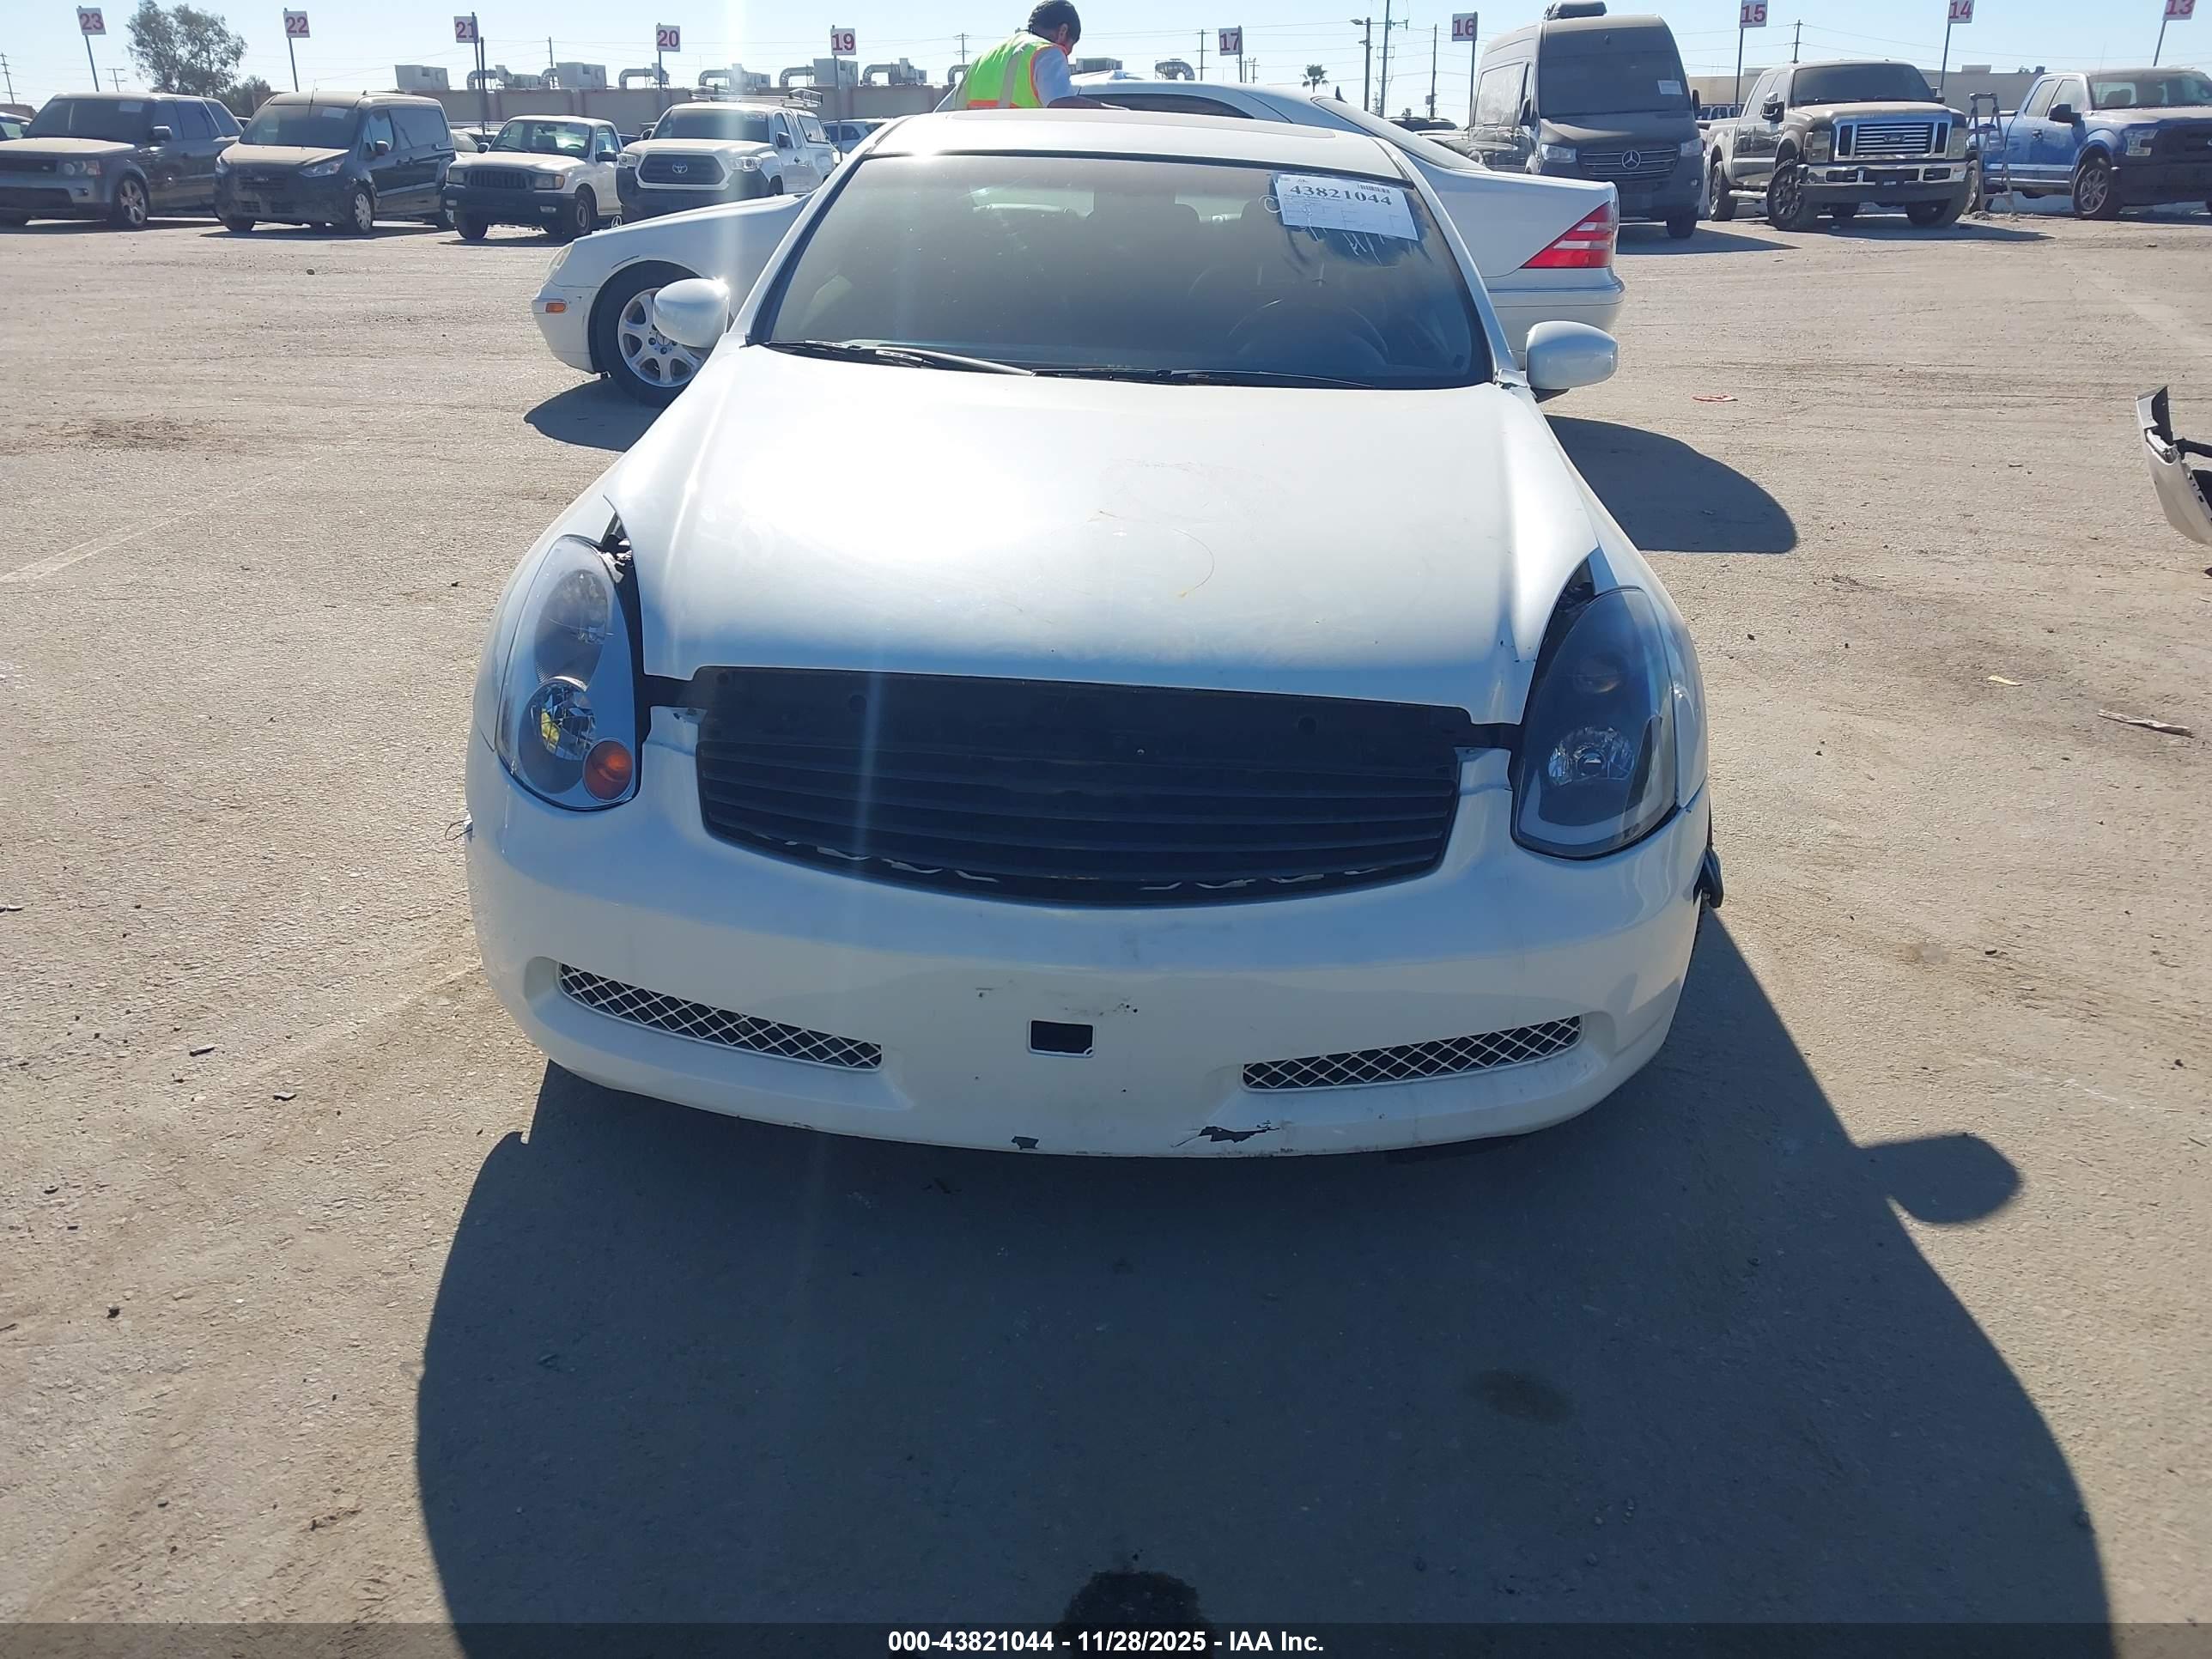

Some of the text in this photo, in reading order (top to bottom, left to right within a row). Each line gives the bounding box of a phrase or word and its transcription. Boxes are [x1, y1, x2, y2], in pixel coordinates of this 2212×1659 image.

[1741, 3, 1766, 22] 15
[1949, 0, 1972, 19] 14
[2165, 0, 2192, 15] 13
[80, 13, 104, 30] 23
[285, 16, 309, 33] 22
[456, 21, 476, 39] 21
[1453, 18, 1475, 36] 16
[658, 29, 679, 47] 20
[832, 33, 854, 51] 19
[1220, 32, 1239, 51] 17
[1289, 184, 1393, 206] 43821044
